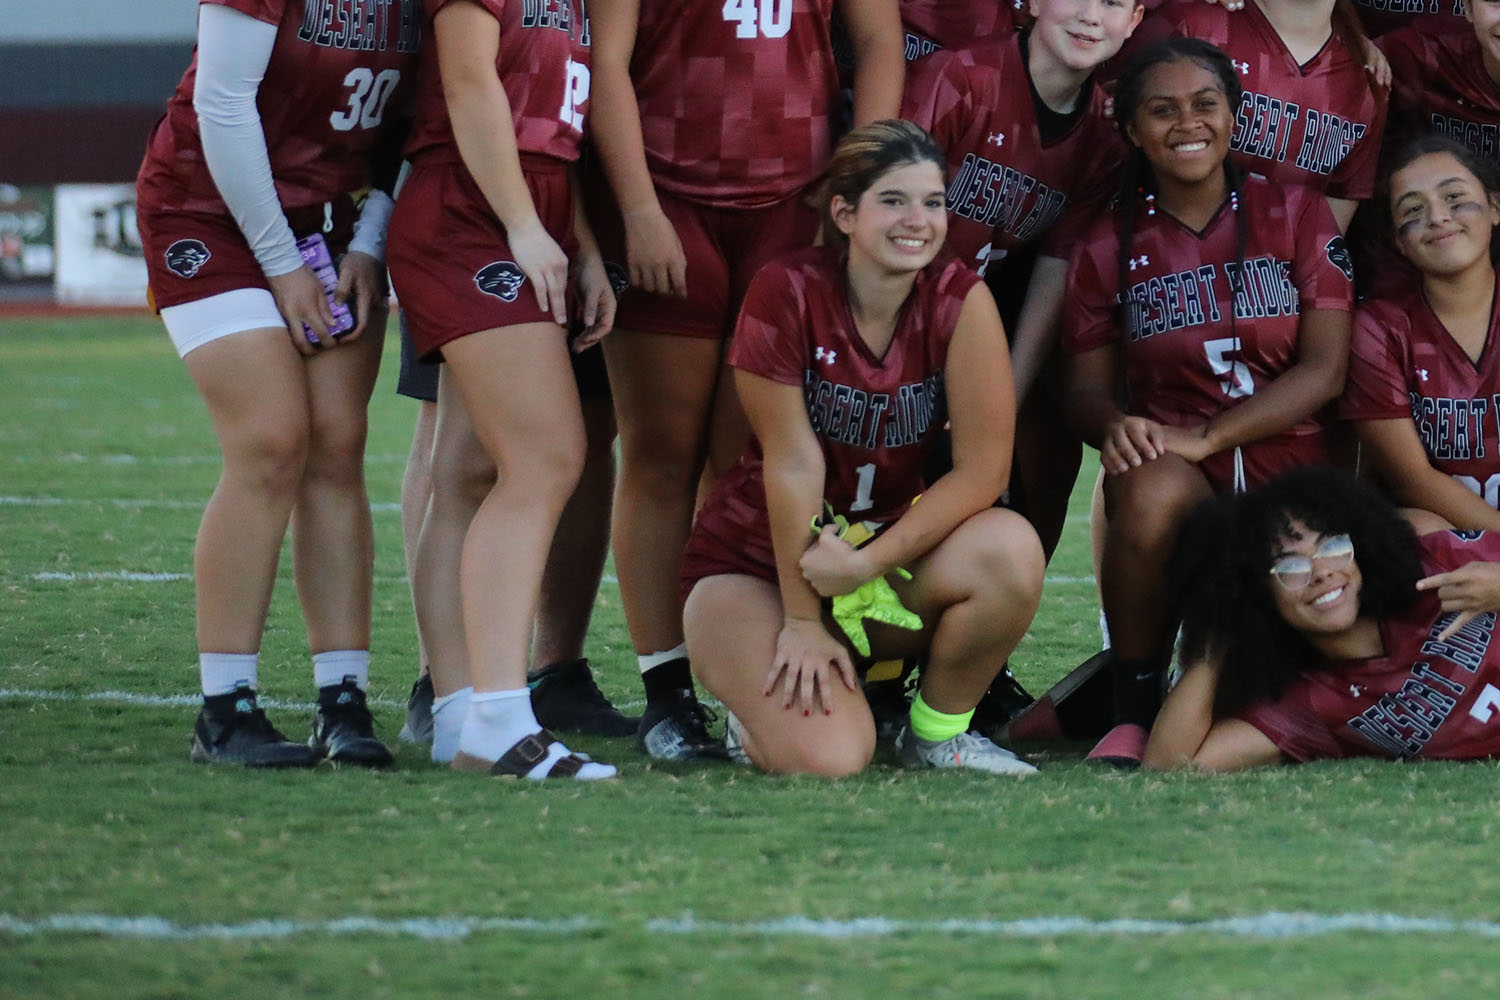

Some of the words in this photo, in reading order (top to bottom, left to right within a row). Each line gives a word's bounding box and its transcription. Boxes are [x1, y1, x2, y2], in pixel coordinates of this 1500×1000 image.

[329, 67, 401, 132] 30
[1229, 90, 1300, 163] SERT
[1203, 337, 1255, 399] 5
[851, 462, 876, 512] 1
